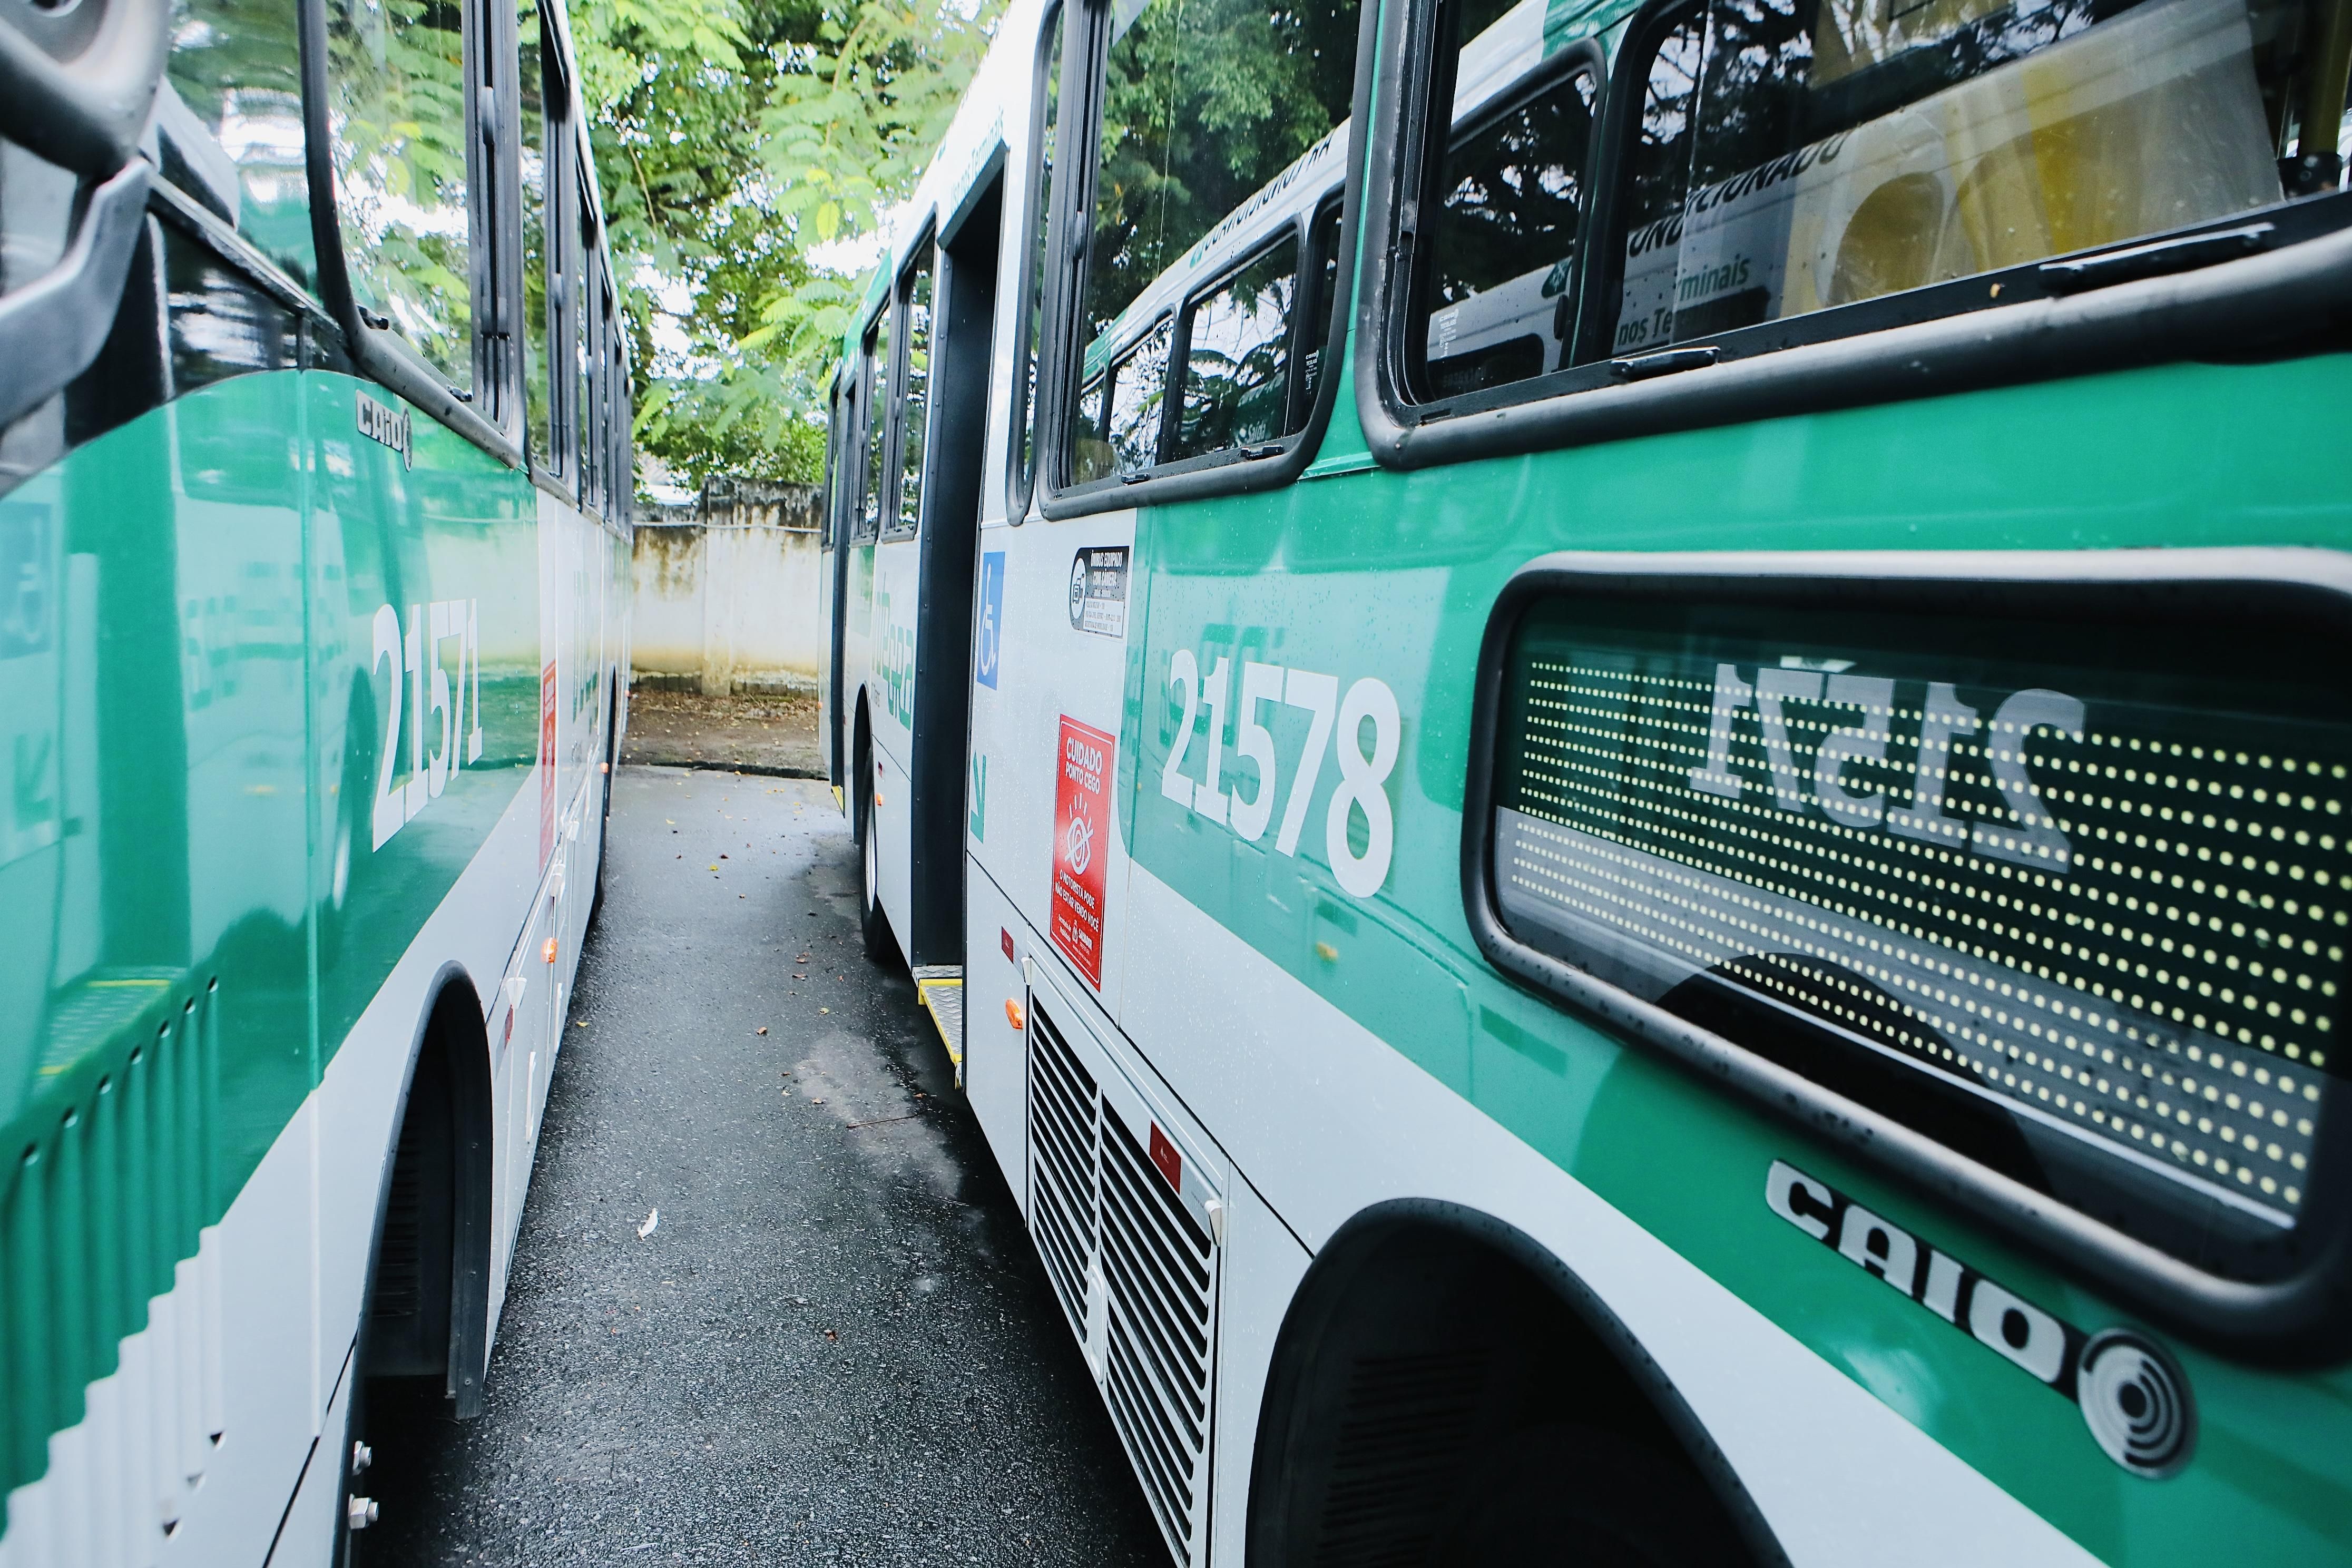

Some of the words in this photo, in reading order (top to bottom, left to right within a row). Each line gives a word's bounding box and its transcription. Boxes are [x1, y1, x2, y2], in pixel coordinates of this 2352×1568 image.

[357, 389, 404, 452] CAIO
[1093, 571, 1102, 586] COM
[1102, 568, 1116, 587] CÂMERA
[373, 598, 483, 852] 21571
[1065, 761, 1084, 785] PONTO
[1084, 771, 1101, 795] CEGO
[1066, 736, 1103, 776] CUIDADO
[1161, 650, 1401, 898] 21578
[1055, 881, 1063, 898] NÃO
[1063, 890, 1074, 909] ESTAR
[1074, 900, 1087, 922] VENDO
[1087, 912, 1100, 933] VOCÊ
[1063, 874, 1084, 901] MOTORISTA
[1084, 891, 1095, 910] PODE
[1765, 1159, 2066, 1384] CAIO
